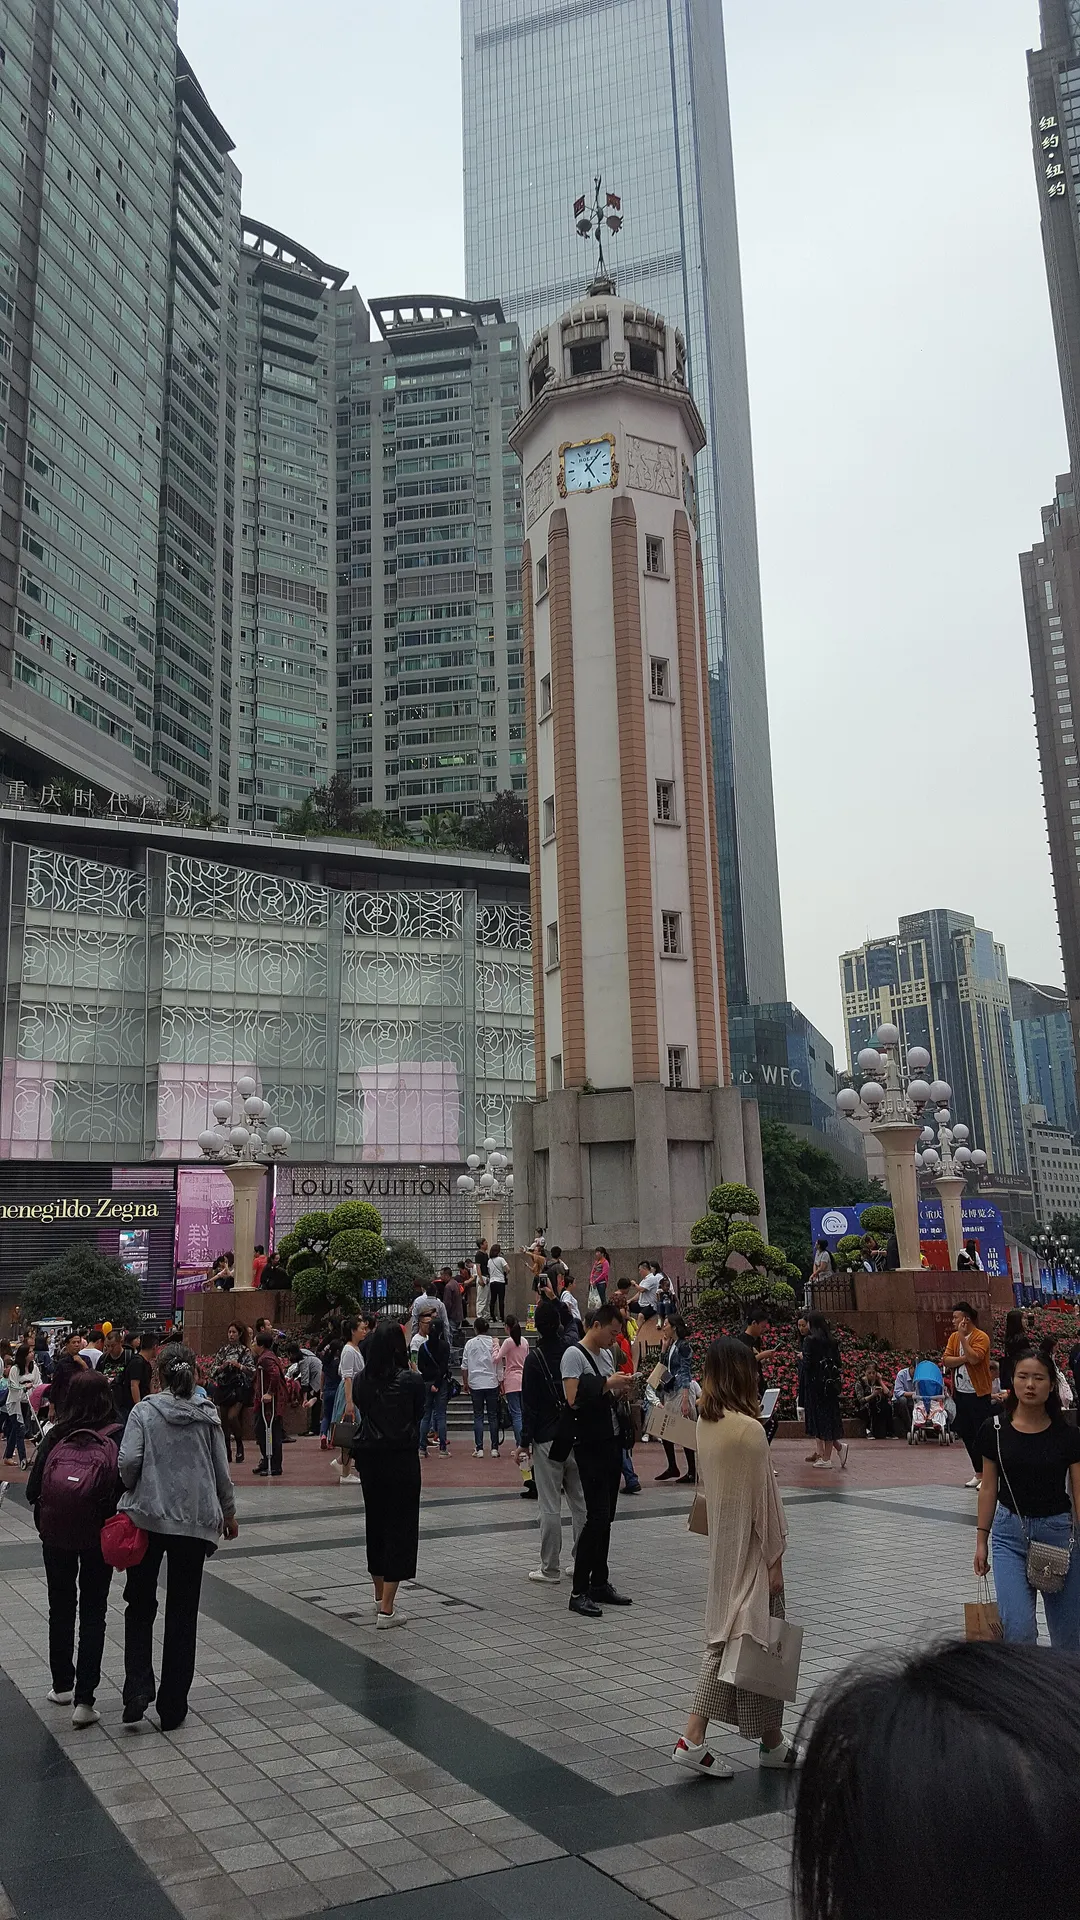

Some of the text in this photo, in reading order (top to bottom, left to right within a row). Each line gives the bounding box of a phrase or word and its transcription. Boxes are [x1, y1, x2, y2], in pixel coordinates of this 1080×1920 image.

[1038, 116, 1066, 197] 纽约·纽约
[5, 780, 192, 821] 重庆时代广场
[761, 1065, 802, 1087] WFC
[292, 1179, 451, 1195] LOUIS VUITTON
[95, 1198, 160, 1222] Zegna
